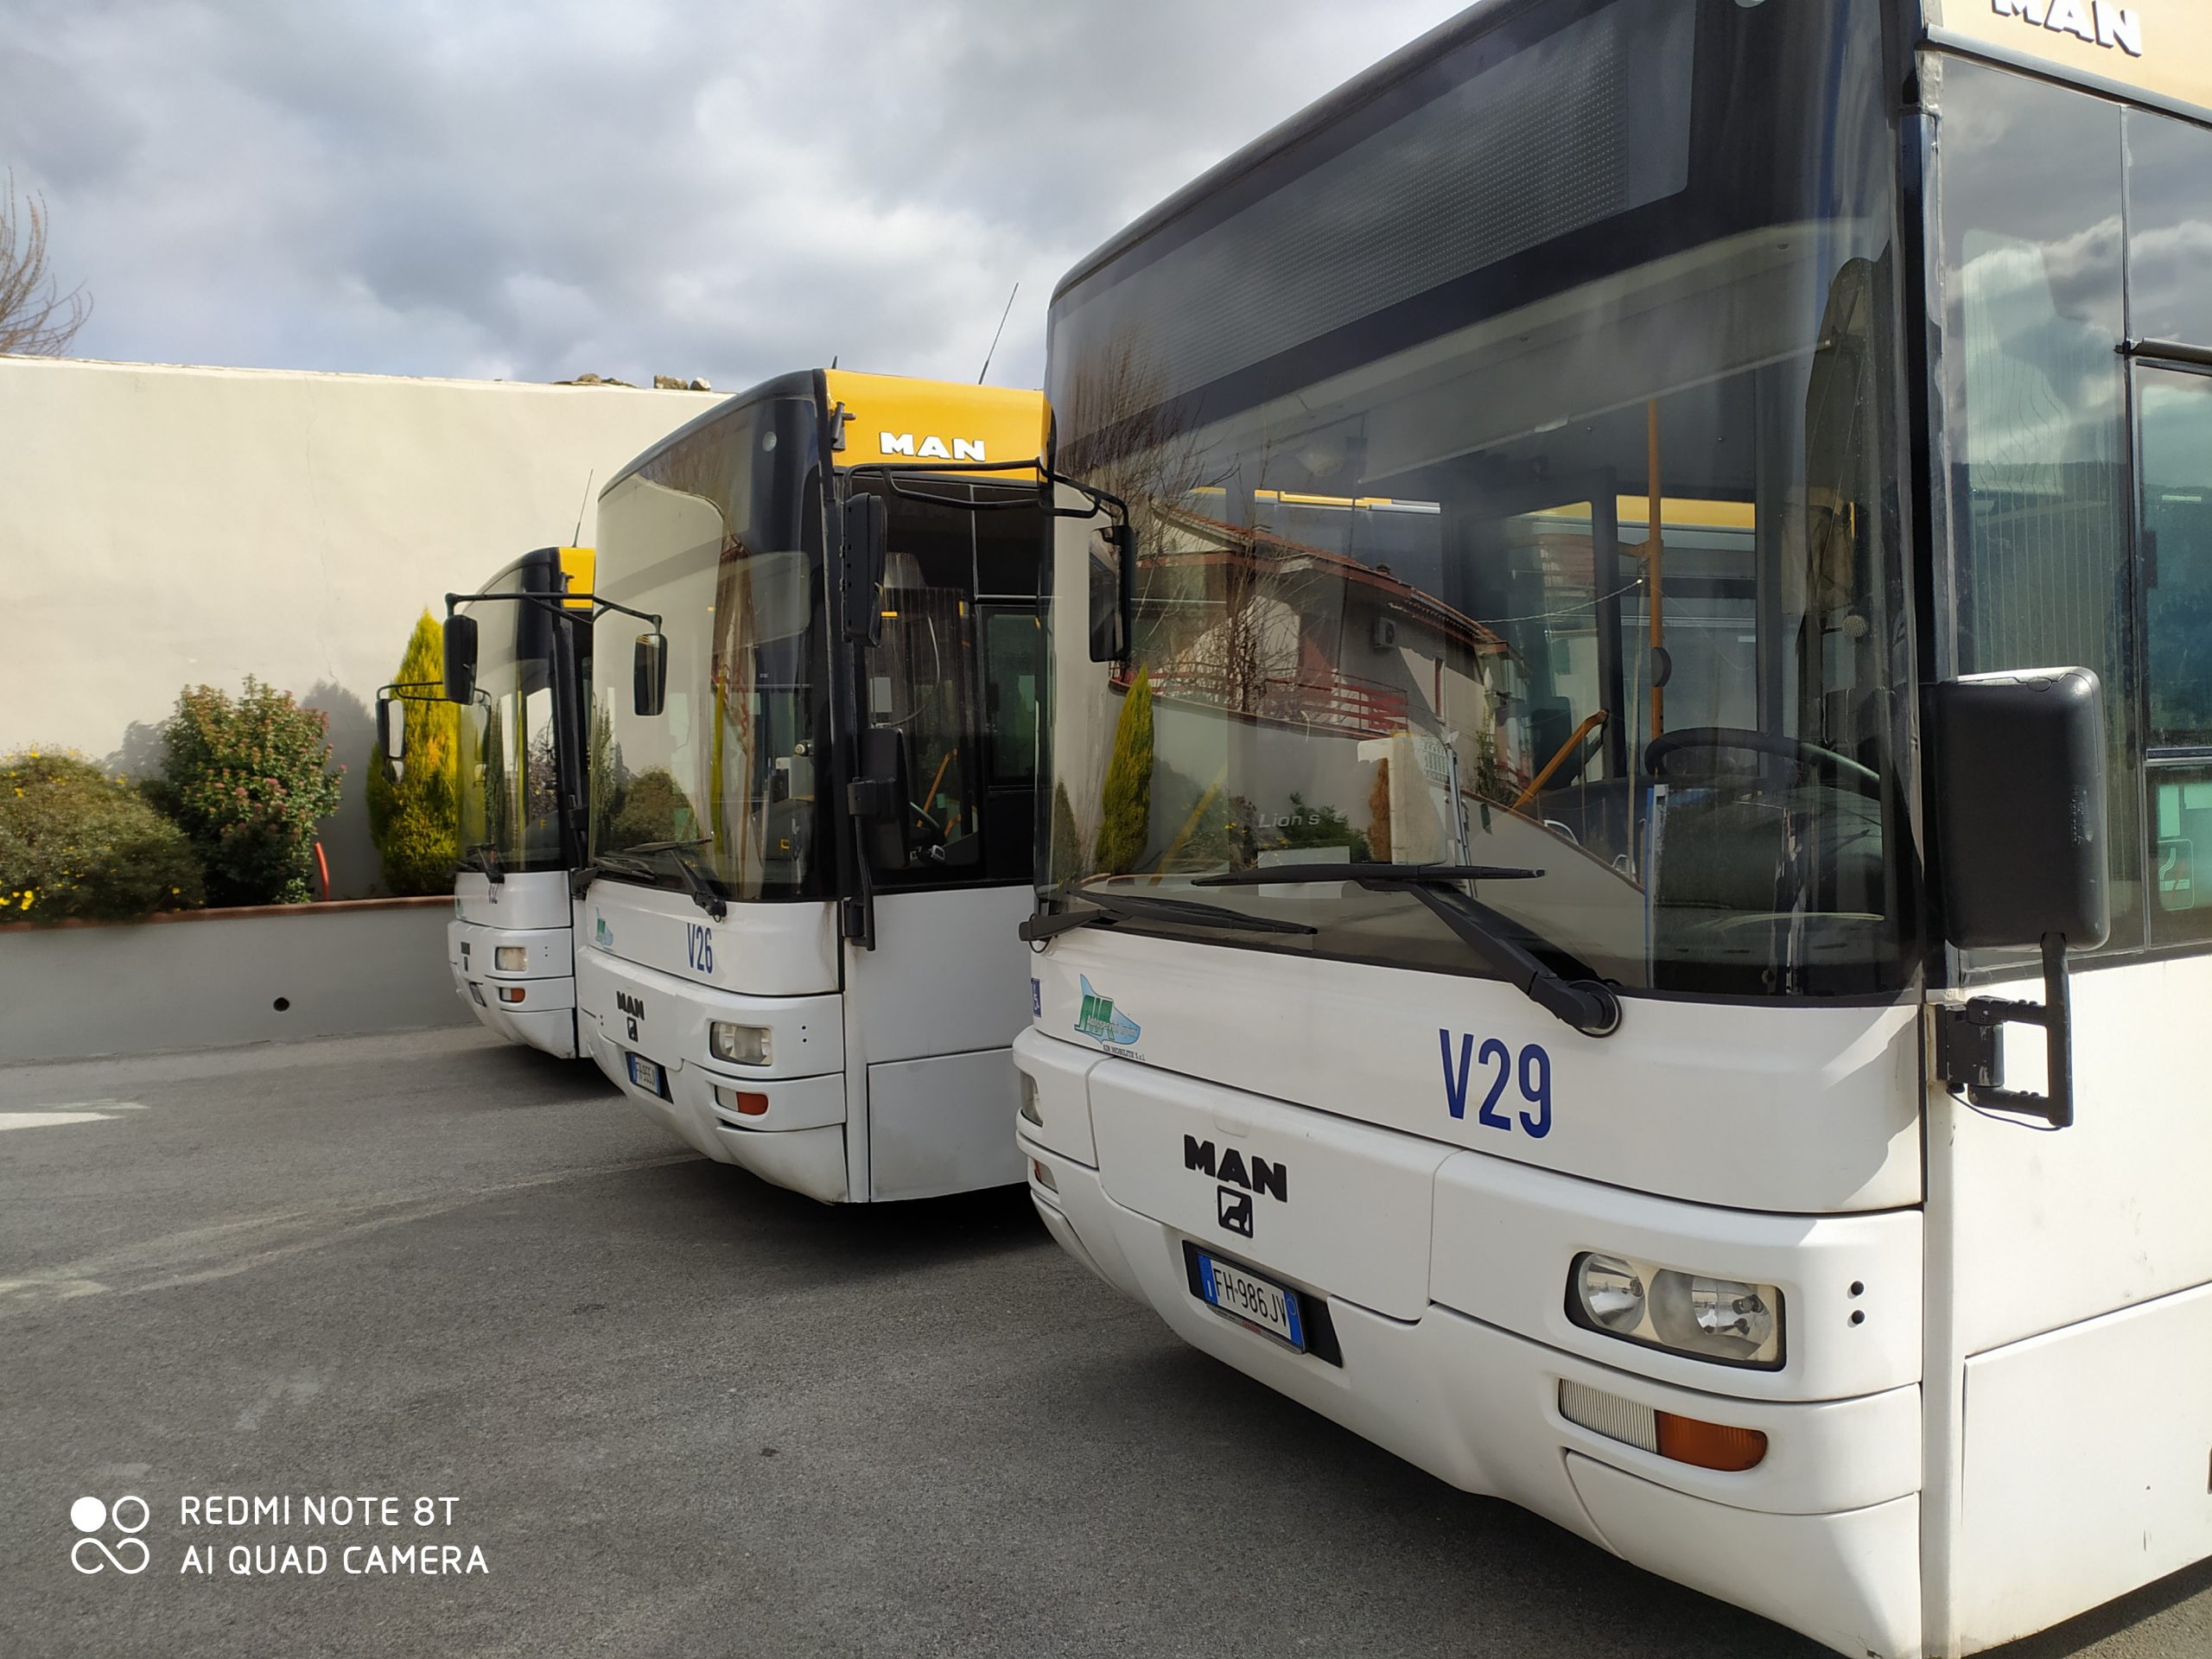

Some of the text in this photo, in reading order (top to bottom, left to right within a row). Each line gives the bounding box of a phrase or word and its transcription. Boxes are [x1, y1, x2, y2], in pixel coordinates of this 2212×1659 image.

[879, 431, 986, 462] MAN
[687, 922, 713, 975] V26
[616, 990, 645, 1020] MAN
[1439, 1028, 1552, 1139] V29
[1184, 1134, 1287, 1204] MAN
